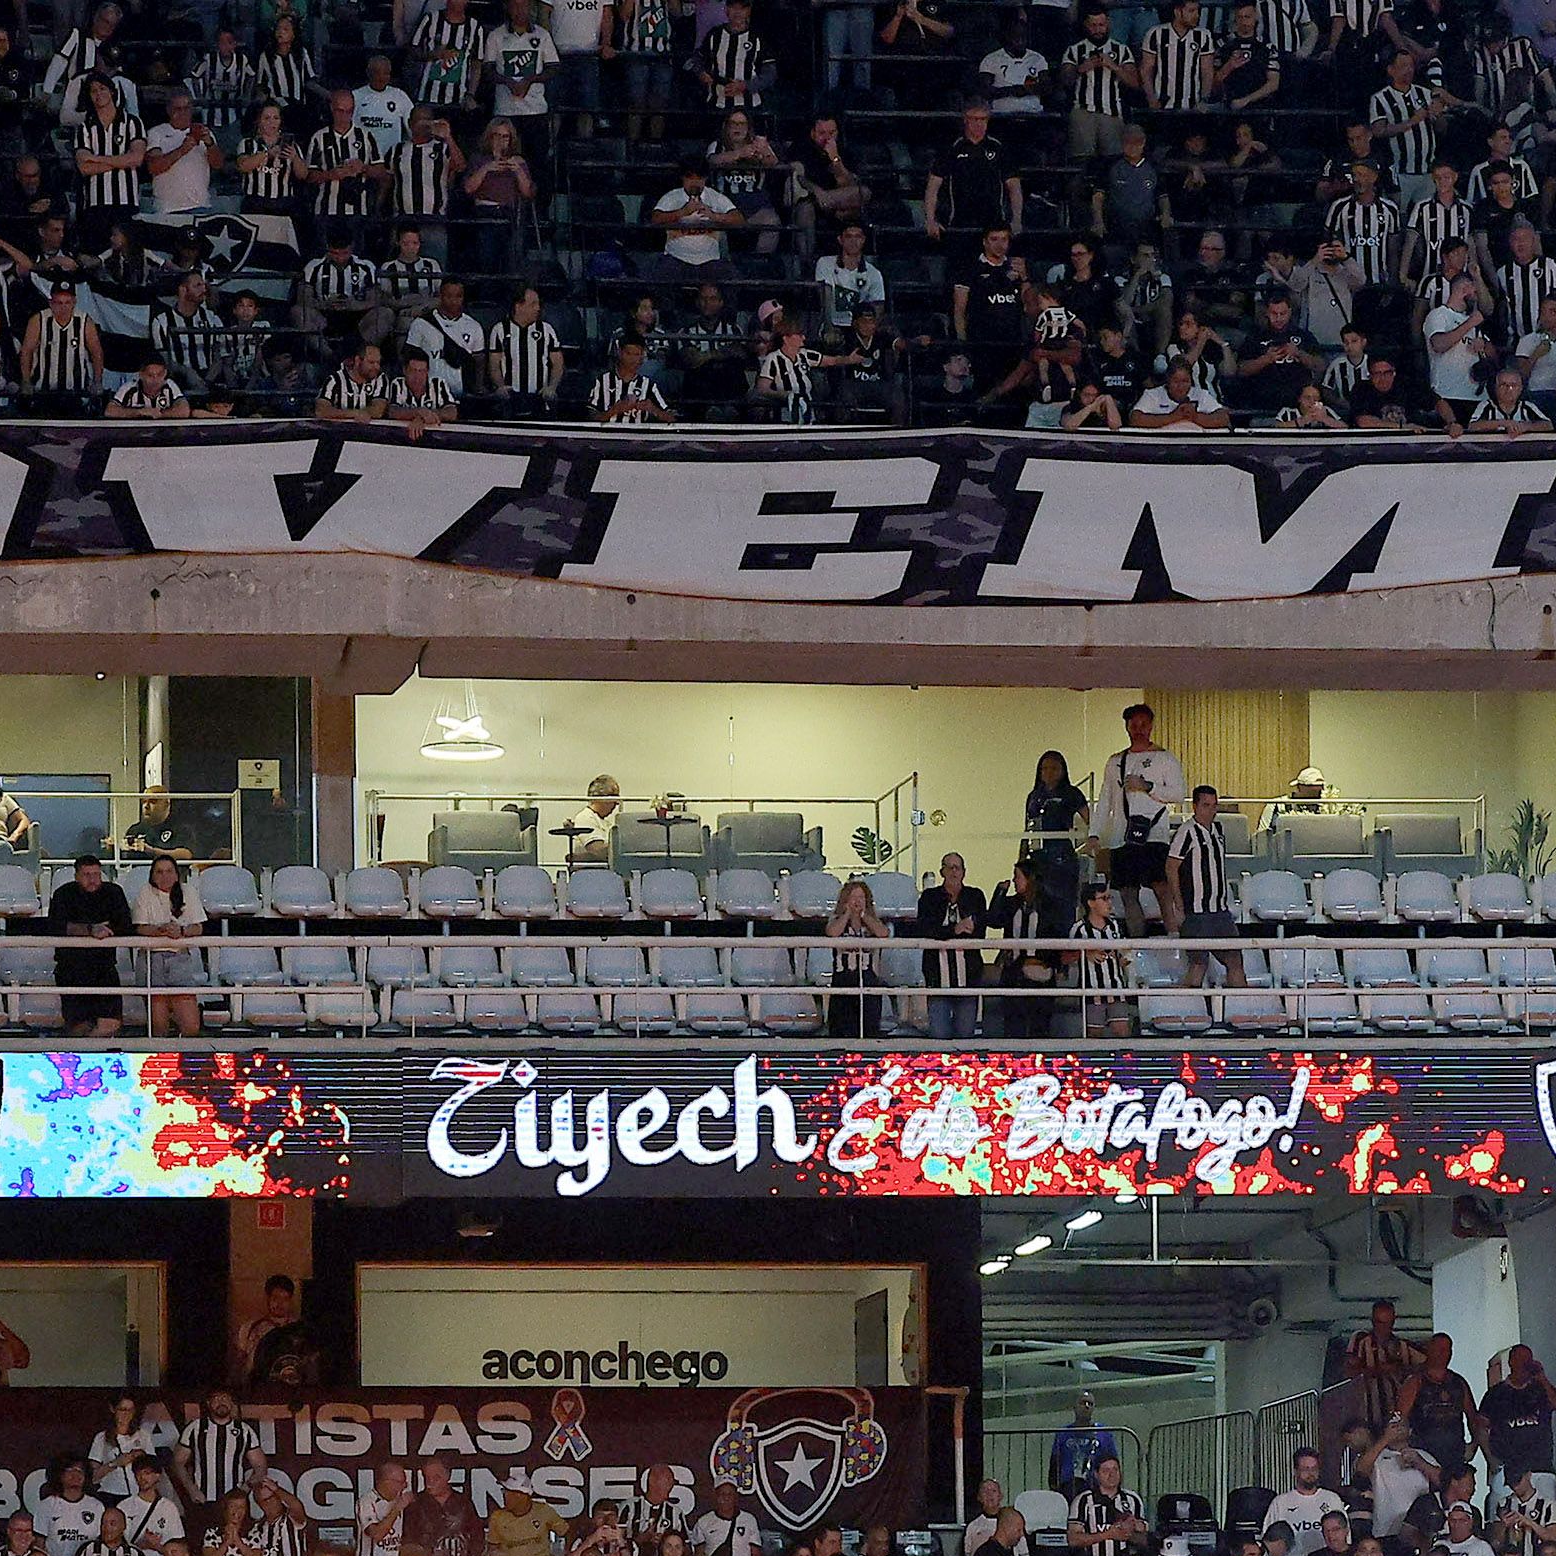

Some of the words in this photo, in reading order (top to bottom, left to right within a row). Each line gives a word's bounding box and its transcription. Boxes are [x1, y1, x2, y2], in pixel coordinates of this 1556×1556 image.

[568, 0, 597, 10] vbet
[509, 52, 532, 74] 7UP
[1350, 237, 1379, 246] vbet
[826, 1064, 903, 1173] É
[901, 1084, 993, 1160] do
[1006, 1066, 1311, 1181] Botafogo!
[482, 1341, 729, 1388] aconchego
[142, 1402, 533, 1456] ATISTAS
[1294, 1521, 1321, 1530] vbe
